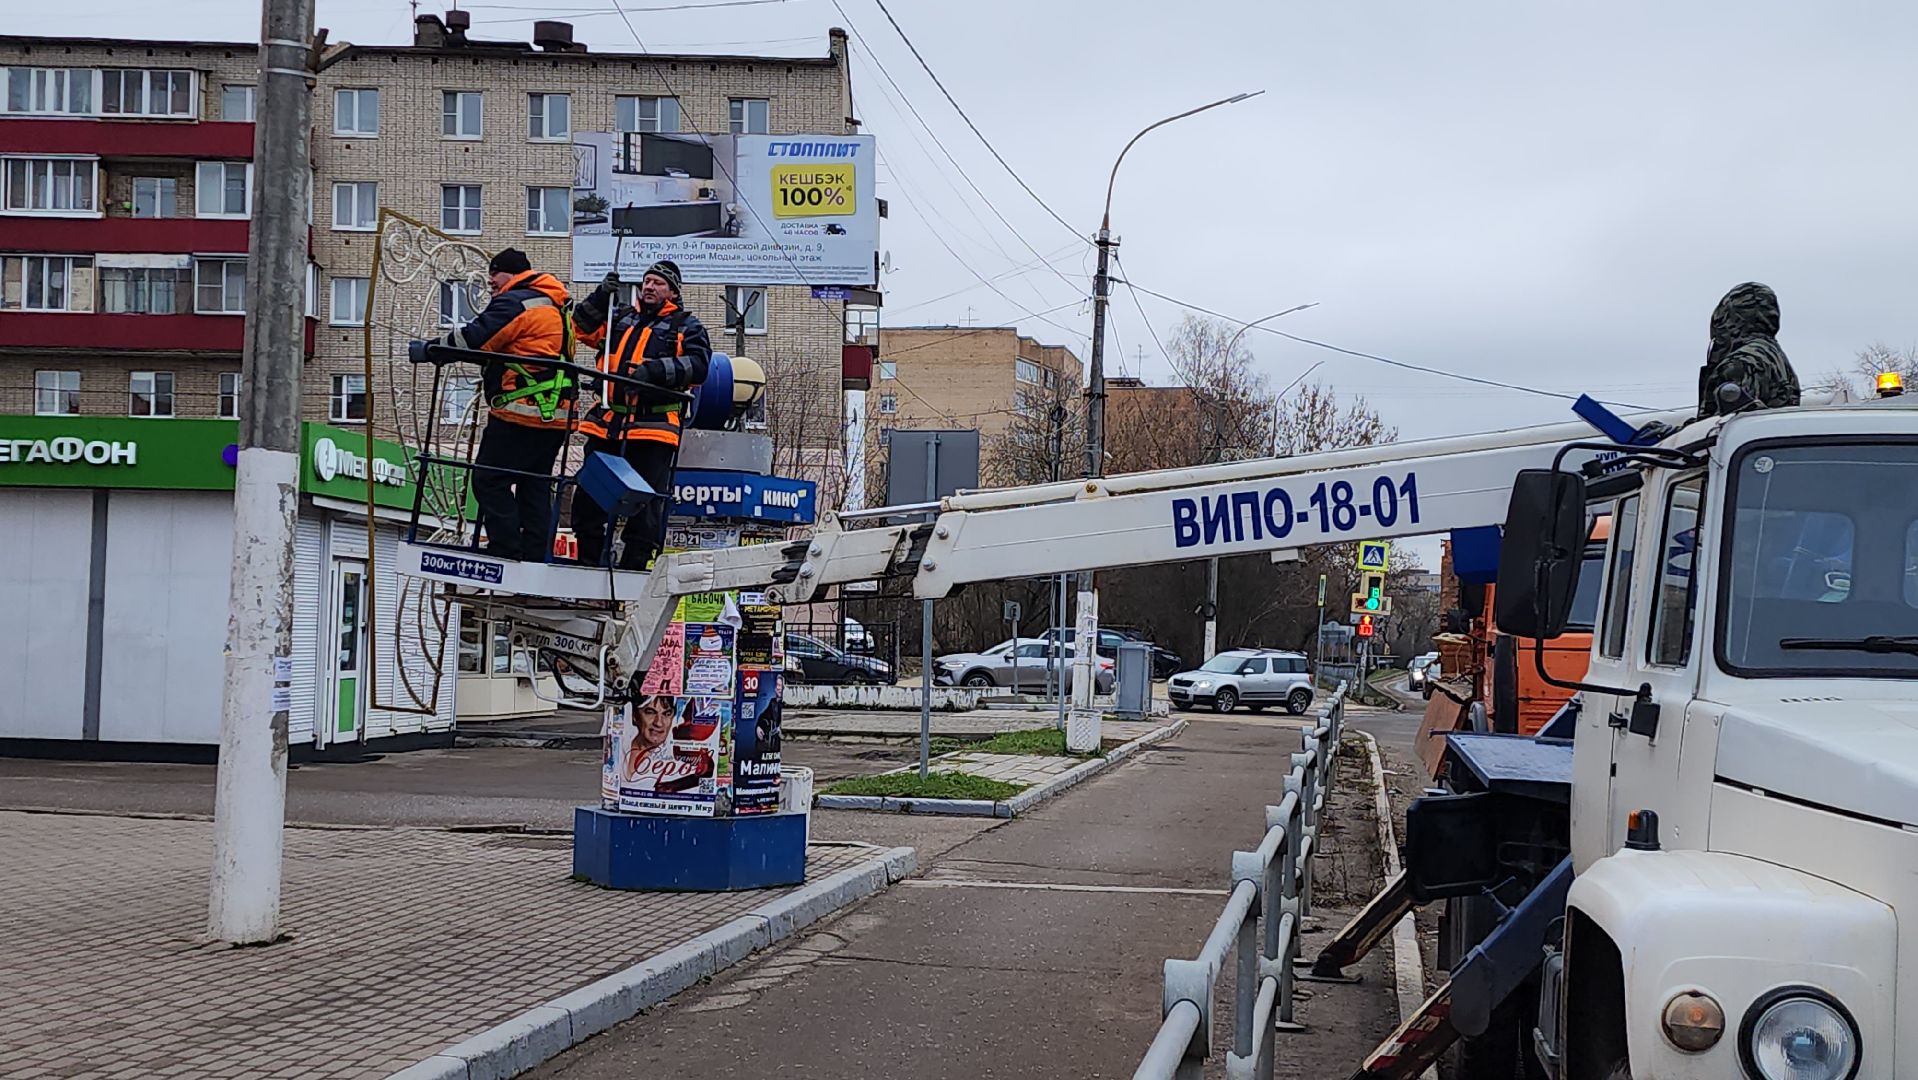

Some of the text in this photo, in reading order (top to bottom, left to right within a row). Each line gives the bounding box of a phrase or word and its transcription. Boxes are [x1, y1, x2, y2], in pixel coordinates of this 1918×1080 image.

[779, 174, 845, 184] КЕШБЭК
[779, 187, 844, 206] 100%
[632, 241, 664, 250] Истра,
[667, 243, 680, 251] ул.
[683, 241, 697, 249] 9-й
[701, 242, 759, 251] Гвардейской
[761, 243, 802, 252] дивизии,
[632, 251, 643, 259] ТК
[646, 252, 705, 261] «Территория
[747, 254, 797, 262] цокольный
[336, 448, 406, 487] МЕГФОН
[1172, 472, 1420, 548] ВИПО-18-01
[554, 635, 575, 650] 300
[743, 676, 758, 690] 30
